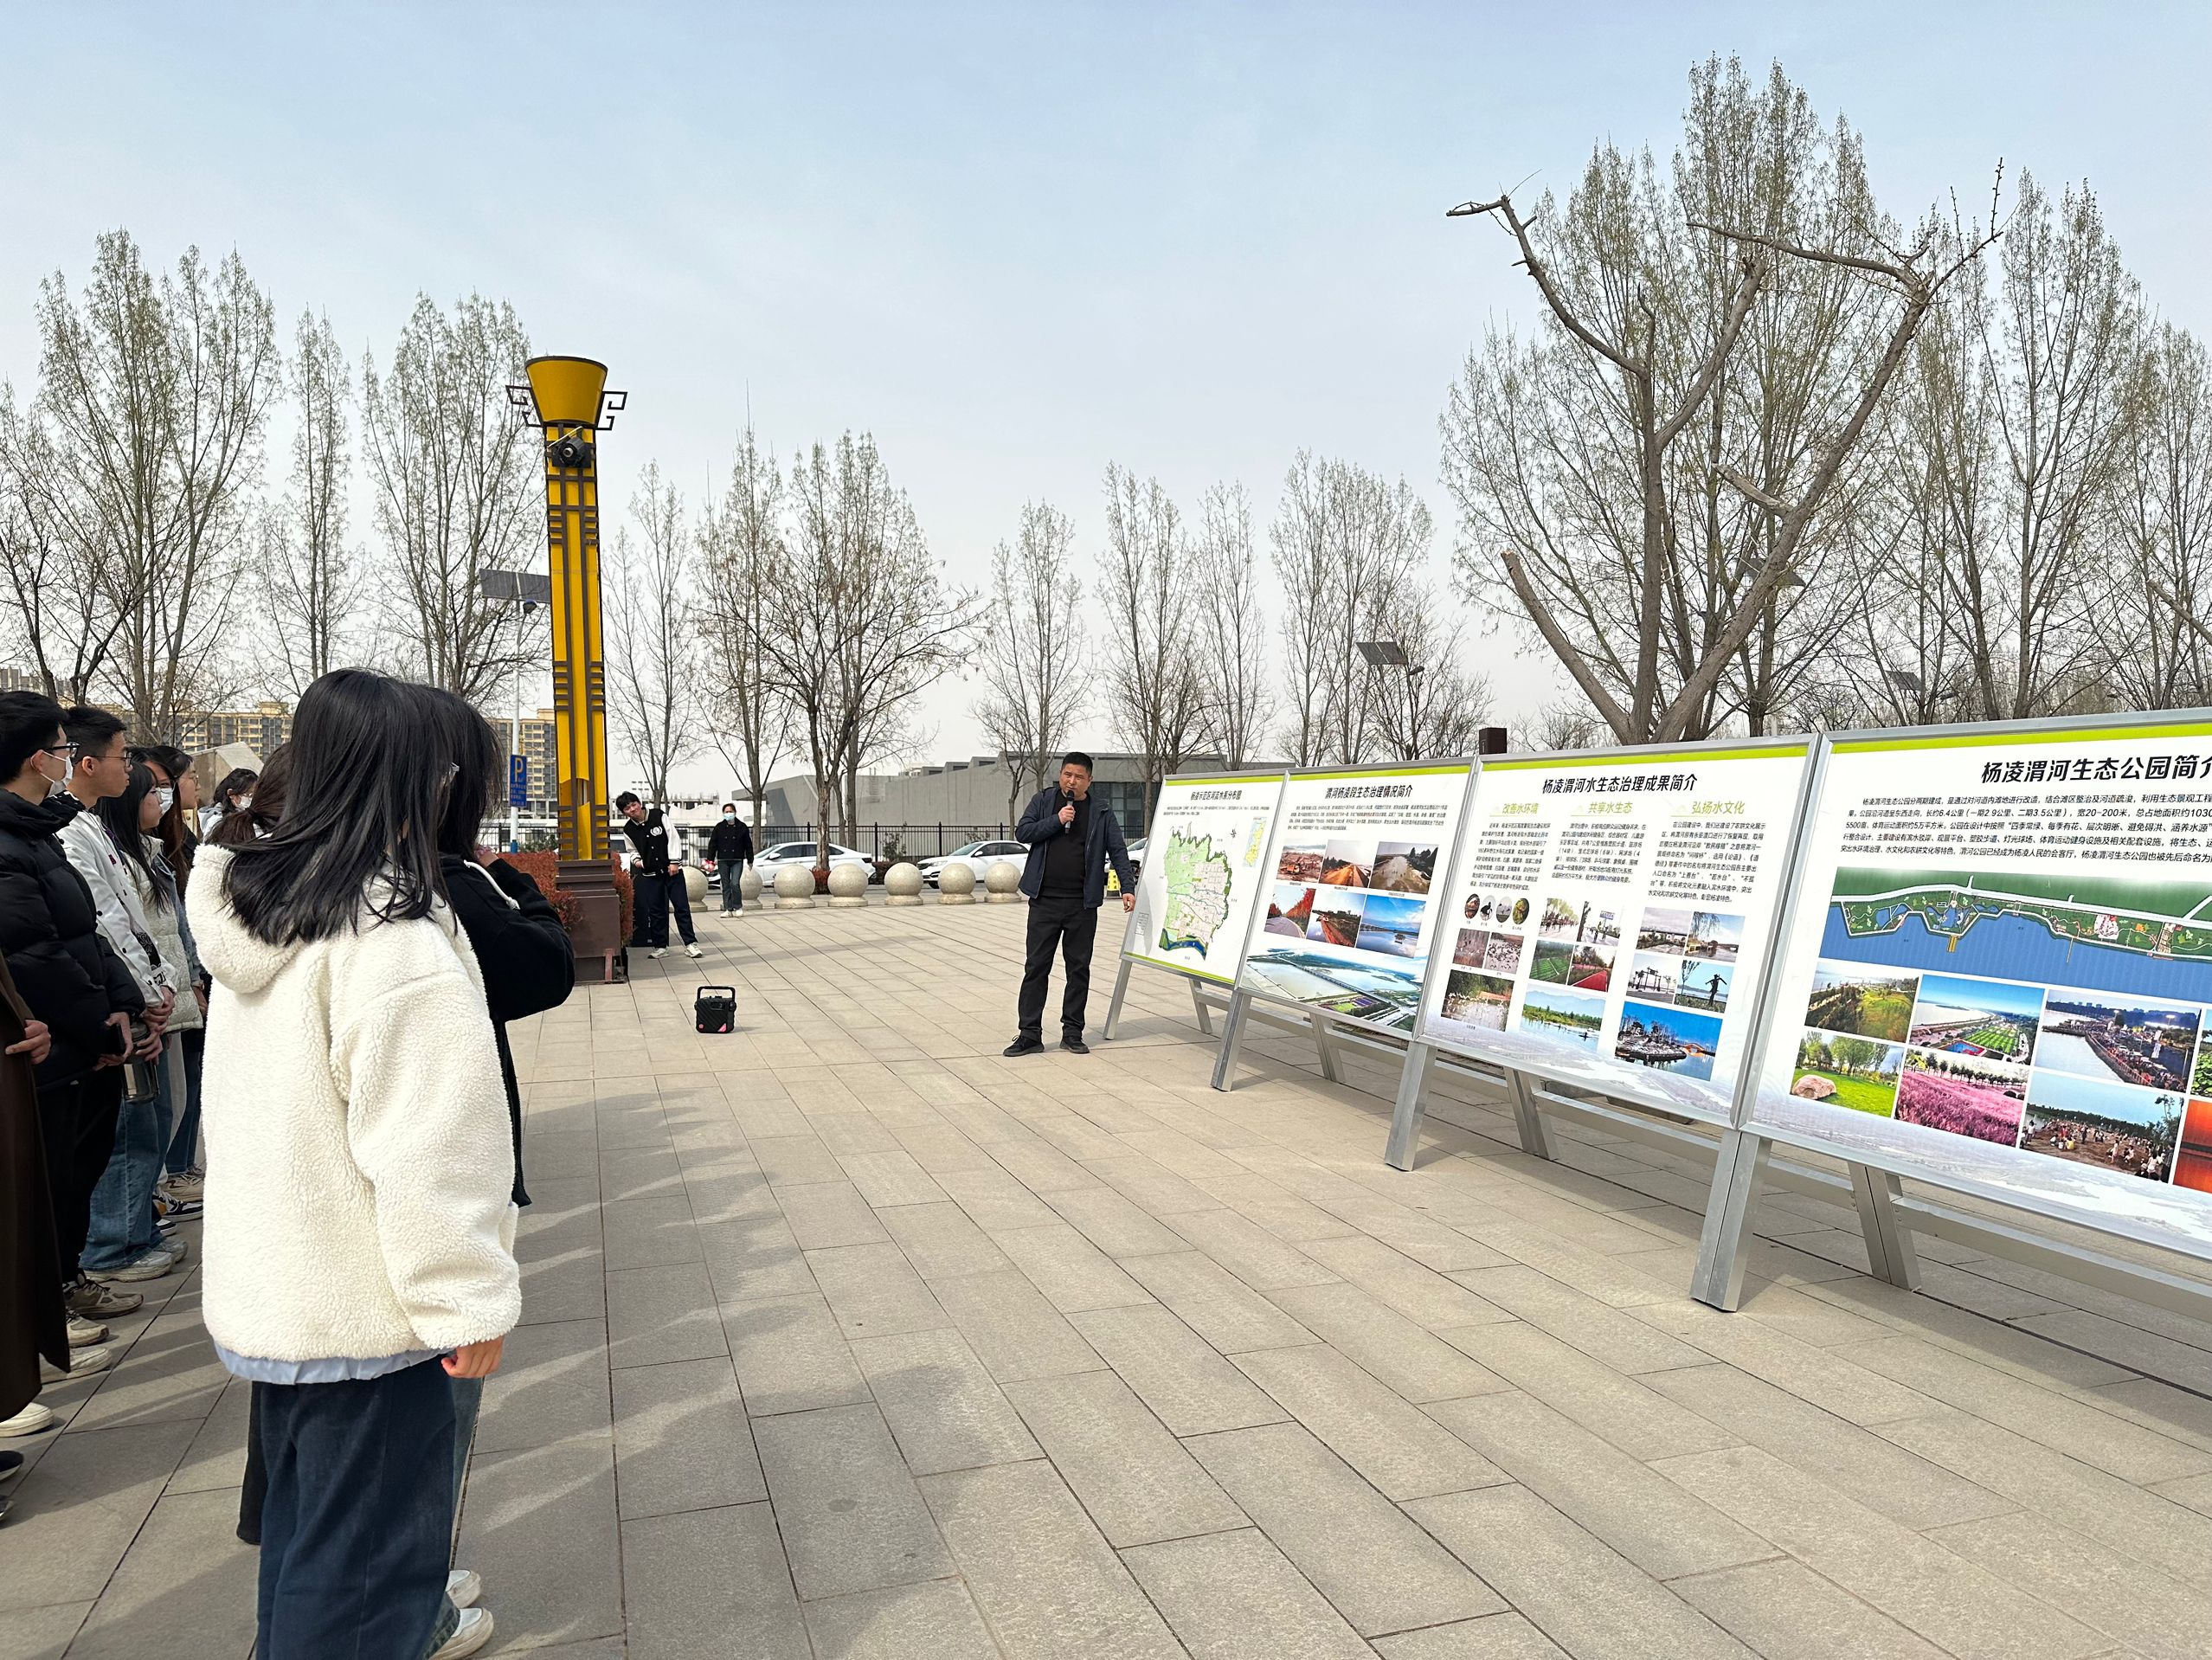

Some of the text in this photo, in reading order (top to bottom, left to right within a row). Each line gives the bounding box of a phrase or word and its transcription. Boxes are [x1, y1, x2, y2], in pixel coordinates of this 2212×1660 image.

[514, 757, 524, 782] P
[1542, 773, 1698, 795] 杨凌渭河水生态治理成果简介
[1501, 803, 1539, 815] 改善水环境
[1588, 801, 1633, 815] 共享水生态
[1692, 800, 1746, 815] 弘扬水文化
